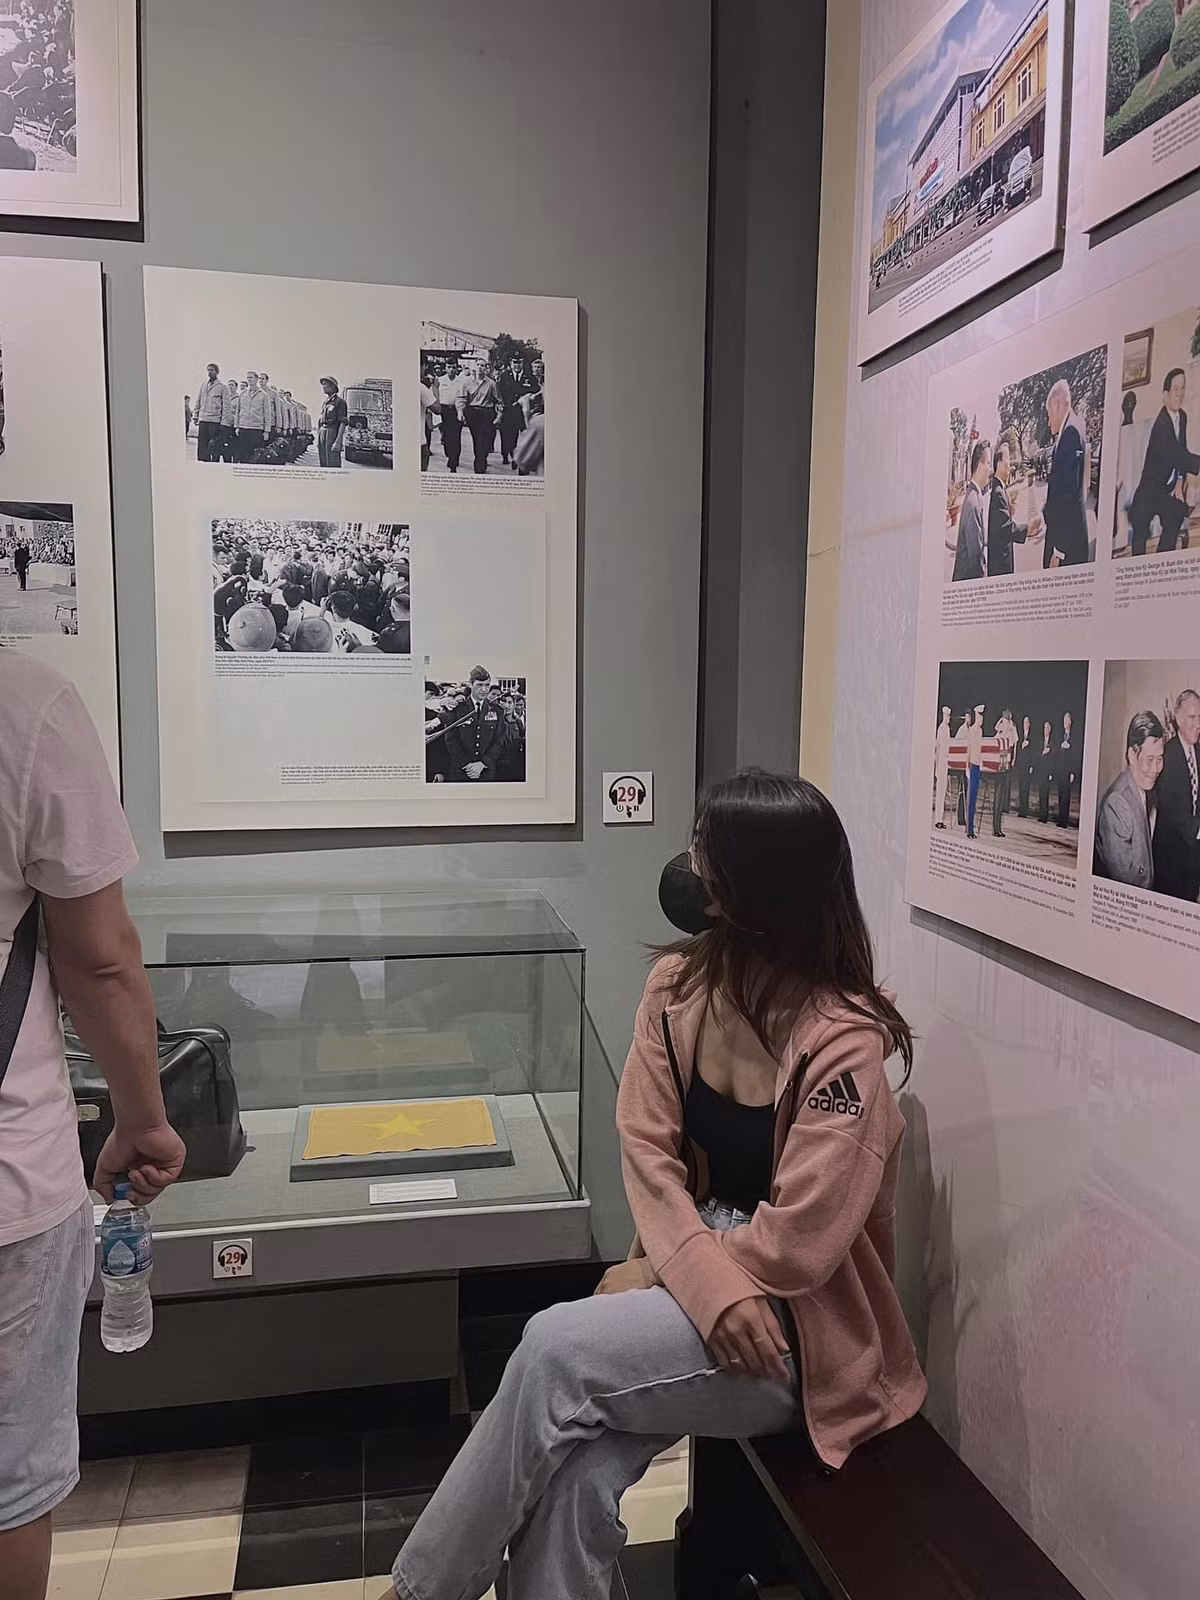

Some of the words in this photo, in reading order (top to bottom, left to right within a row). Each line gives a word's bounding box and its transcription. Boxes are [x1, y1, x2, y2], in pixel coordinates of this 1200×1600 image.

[618, 786, 636, 802] 29
[808, 1096, 865, 1119] adidas
[225, 1251, 240, 1264] 29
